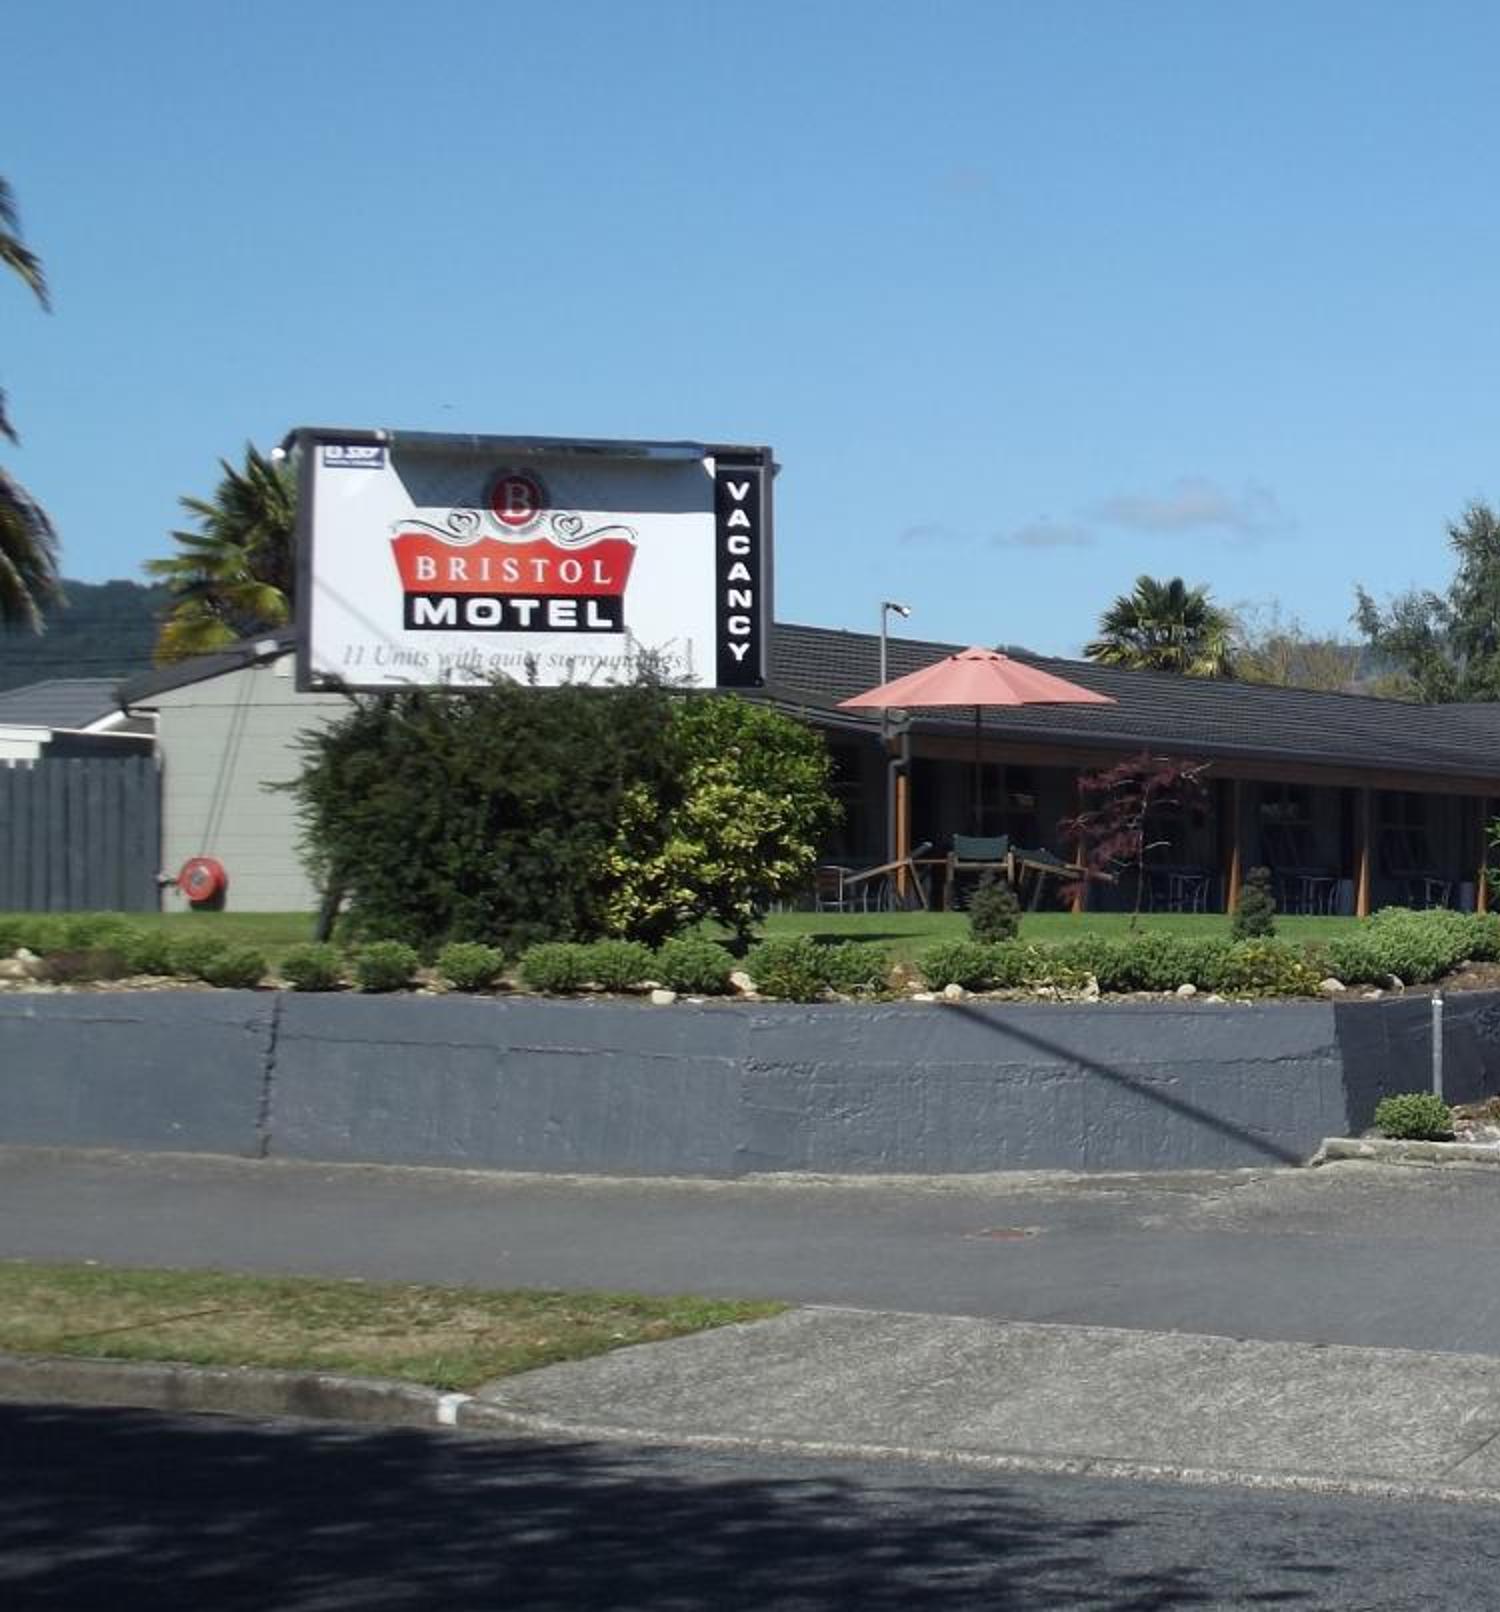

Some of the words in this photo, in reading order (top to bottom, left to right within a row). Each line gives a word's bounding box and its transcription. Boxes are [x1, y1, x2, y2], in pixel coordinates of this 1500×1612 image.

[503, 482, 532, 518] B
[415, 554, 613, 585] BRISTOL
[725, 481, 754, 662] VACANCY
[412, 596, 614, 628] MOTEL
[343, 644, 365, 665] 11
[373, 644, 430, 668] Units
[437, 647, 483, 669] with
